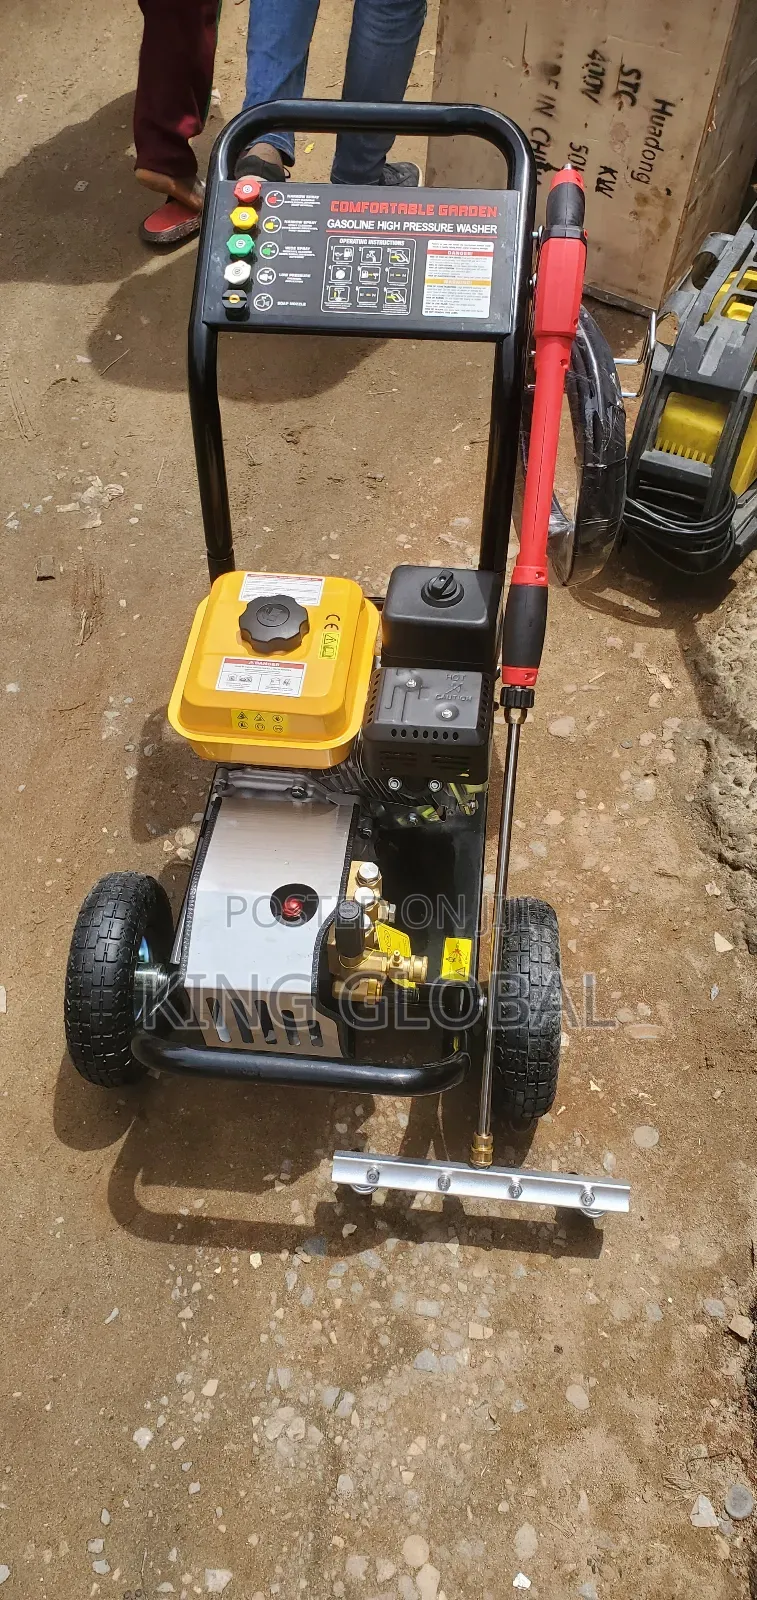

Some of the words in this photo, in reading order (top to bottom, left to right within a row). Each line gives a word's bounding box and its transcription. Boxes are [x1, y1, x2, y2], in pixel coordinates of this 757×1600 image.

[581, 49, 607, 105] 400V
[614, 63, 642, 108] STC
[630, 98, 676, 185] Huadong
[330, 200, 435, 216] COMFORTABLE
[438, 204, 498, 218] GARDEN
[326, 218, 375, 230] GASOLINE
[377, 220, 401, 231] HIGH
[403, 221, 454, 233] PRESSURE
[456, 223, 498, 234] WASHER
[368, 238, 405, 246] INSTRUCTIONS
[435, 693, 473, 702] CAUTION
